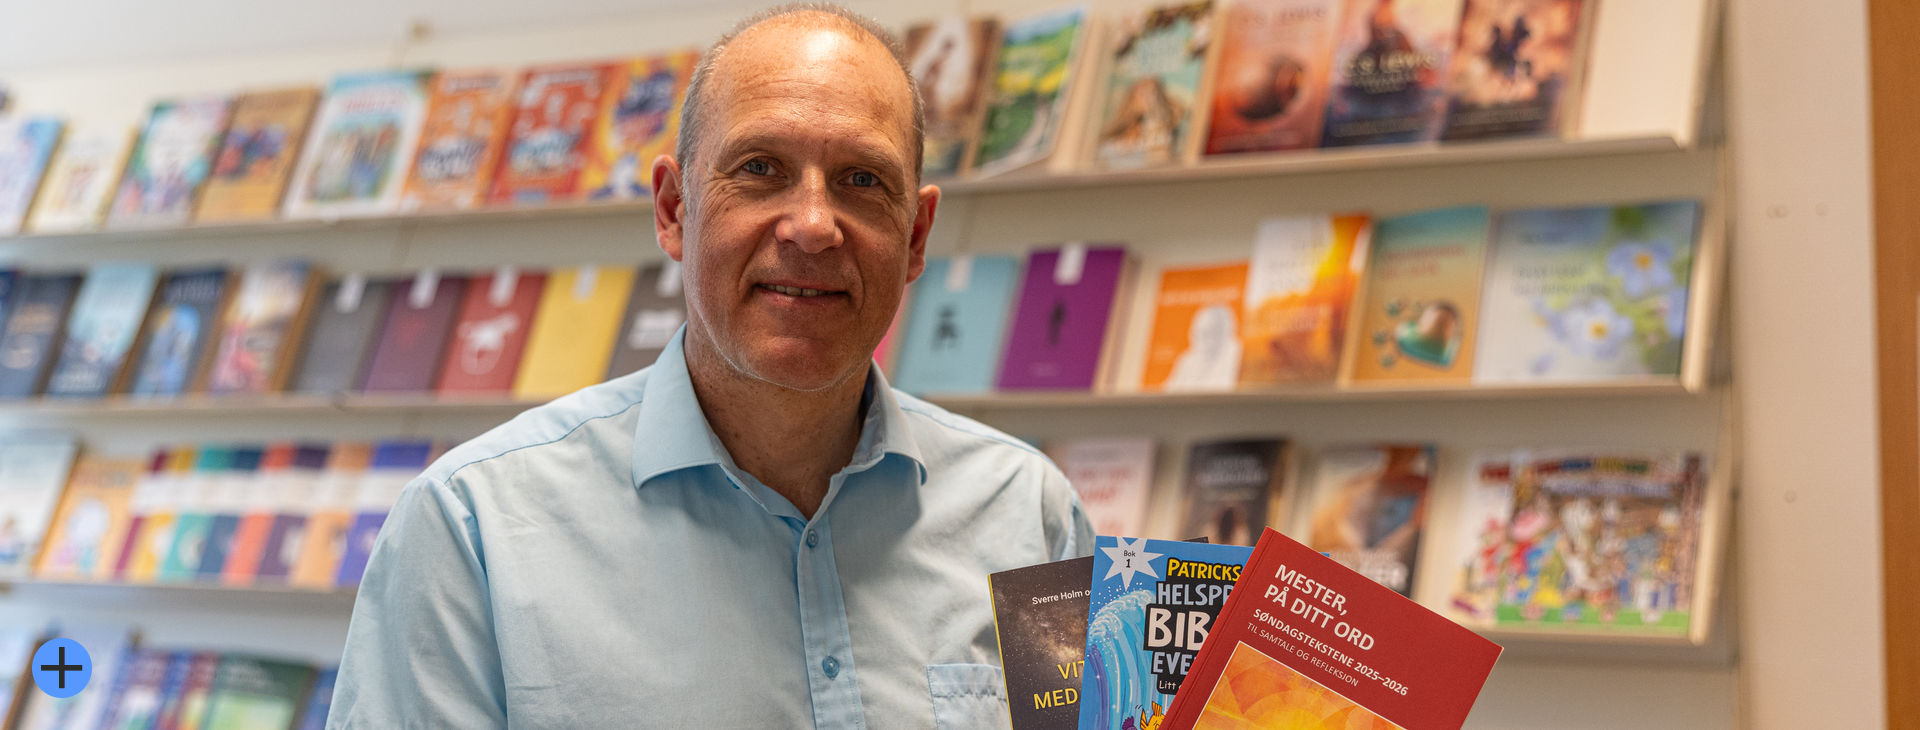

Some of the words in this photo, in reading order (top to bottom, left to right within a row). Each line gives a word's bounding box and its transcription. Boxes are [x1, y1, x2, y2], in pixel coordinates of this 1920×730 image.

[1126, 559, 1131, 568] 1
[1168, 559, 1242, 581] PATRICKS
[1032, 593, 1059, 605] Sverre
[1061, 588, 1083, 600] Holm
[1275, 564, 1348, 616] MESTER,
[1147, 608, 1216, 650] BIB
[1264, 584, 1290, 608] PÅ
[1290, 598, 1334, 629] DITT
[1334, 622, 1374, 651] ORD
[1253, 608, 1354, 668] SØNDAGSTEKSTENE
[1153, 652, 1197, 675] EVE
[1247, 622, 1259, 634] TIL
[1259, 629, 1295, 654] SAMTALE
[1296, 649, 1309, 661] OG
[1311, 656, 1359, 687] REFLEKSJON
[1159, 680, 1176, 690] Litt
[1033, 687, 1078, 710] MED
